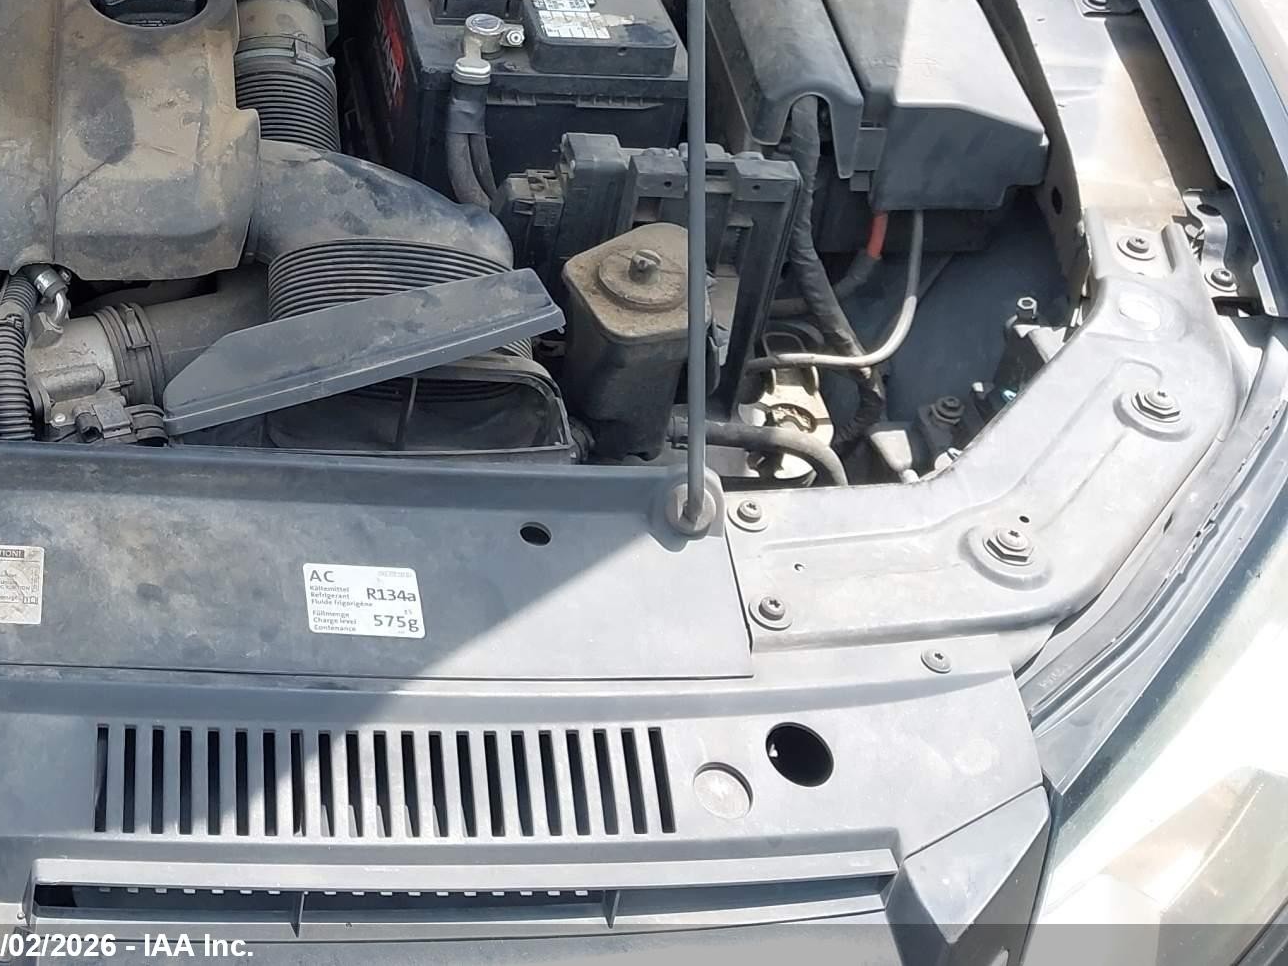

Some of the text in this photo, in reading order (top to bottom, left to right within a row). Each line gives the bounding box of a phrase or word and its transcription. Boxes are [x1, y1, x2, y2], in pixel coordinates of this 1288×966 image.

[309, 569, 335, 583] AC
[310, 591, 350, 600] Refrigerant
[366, 587, 417, 602] R134a
[313, 616, 339, 625] Charge
[373, 614, 419, 633] 575g
